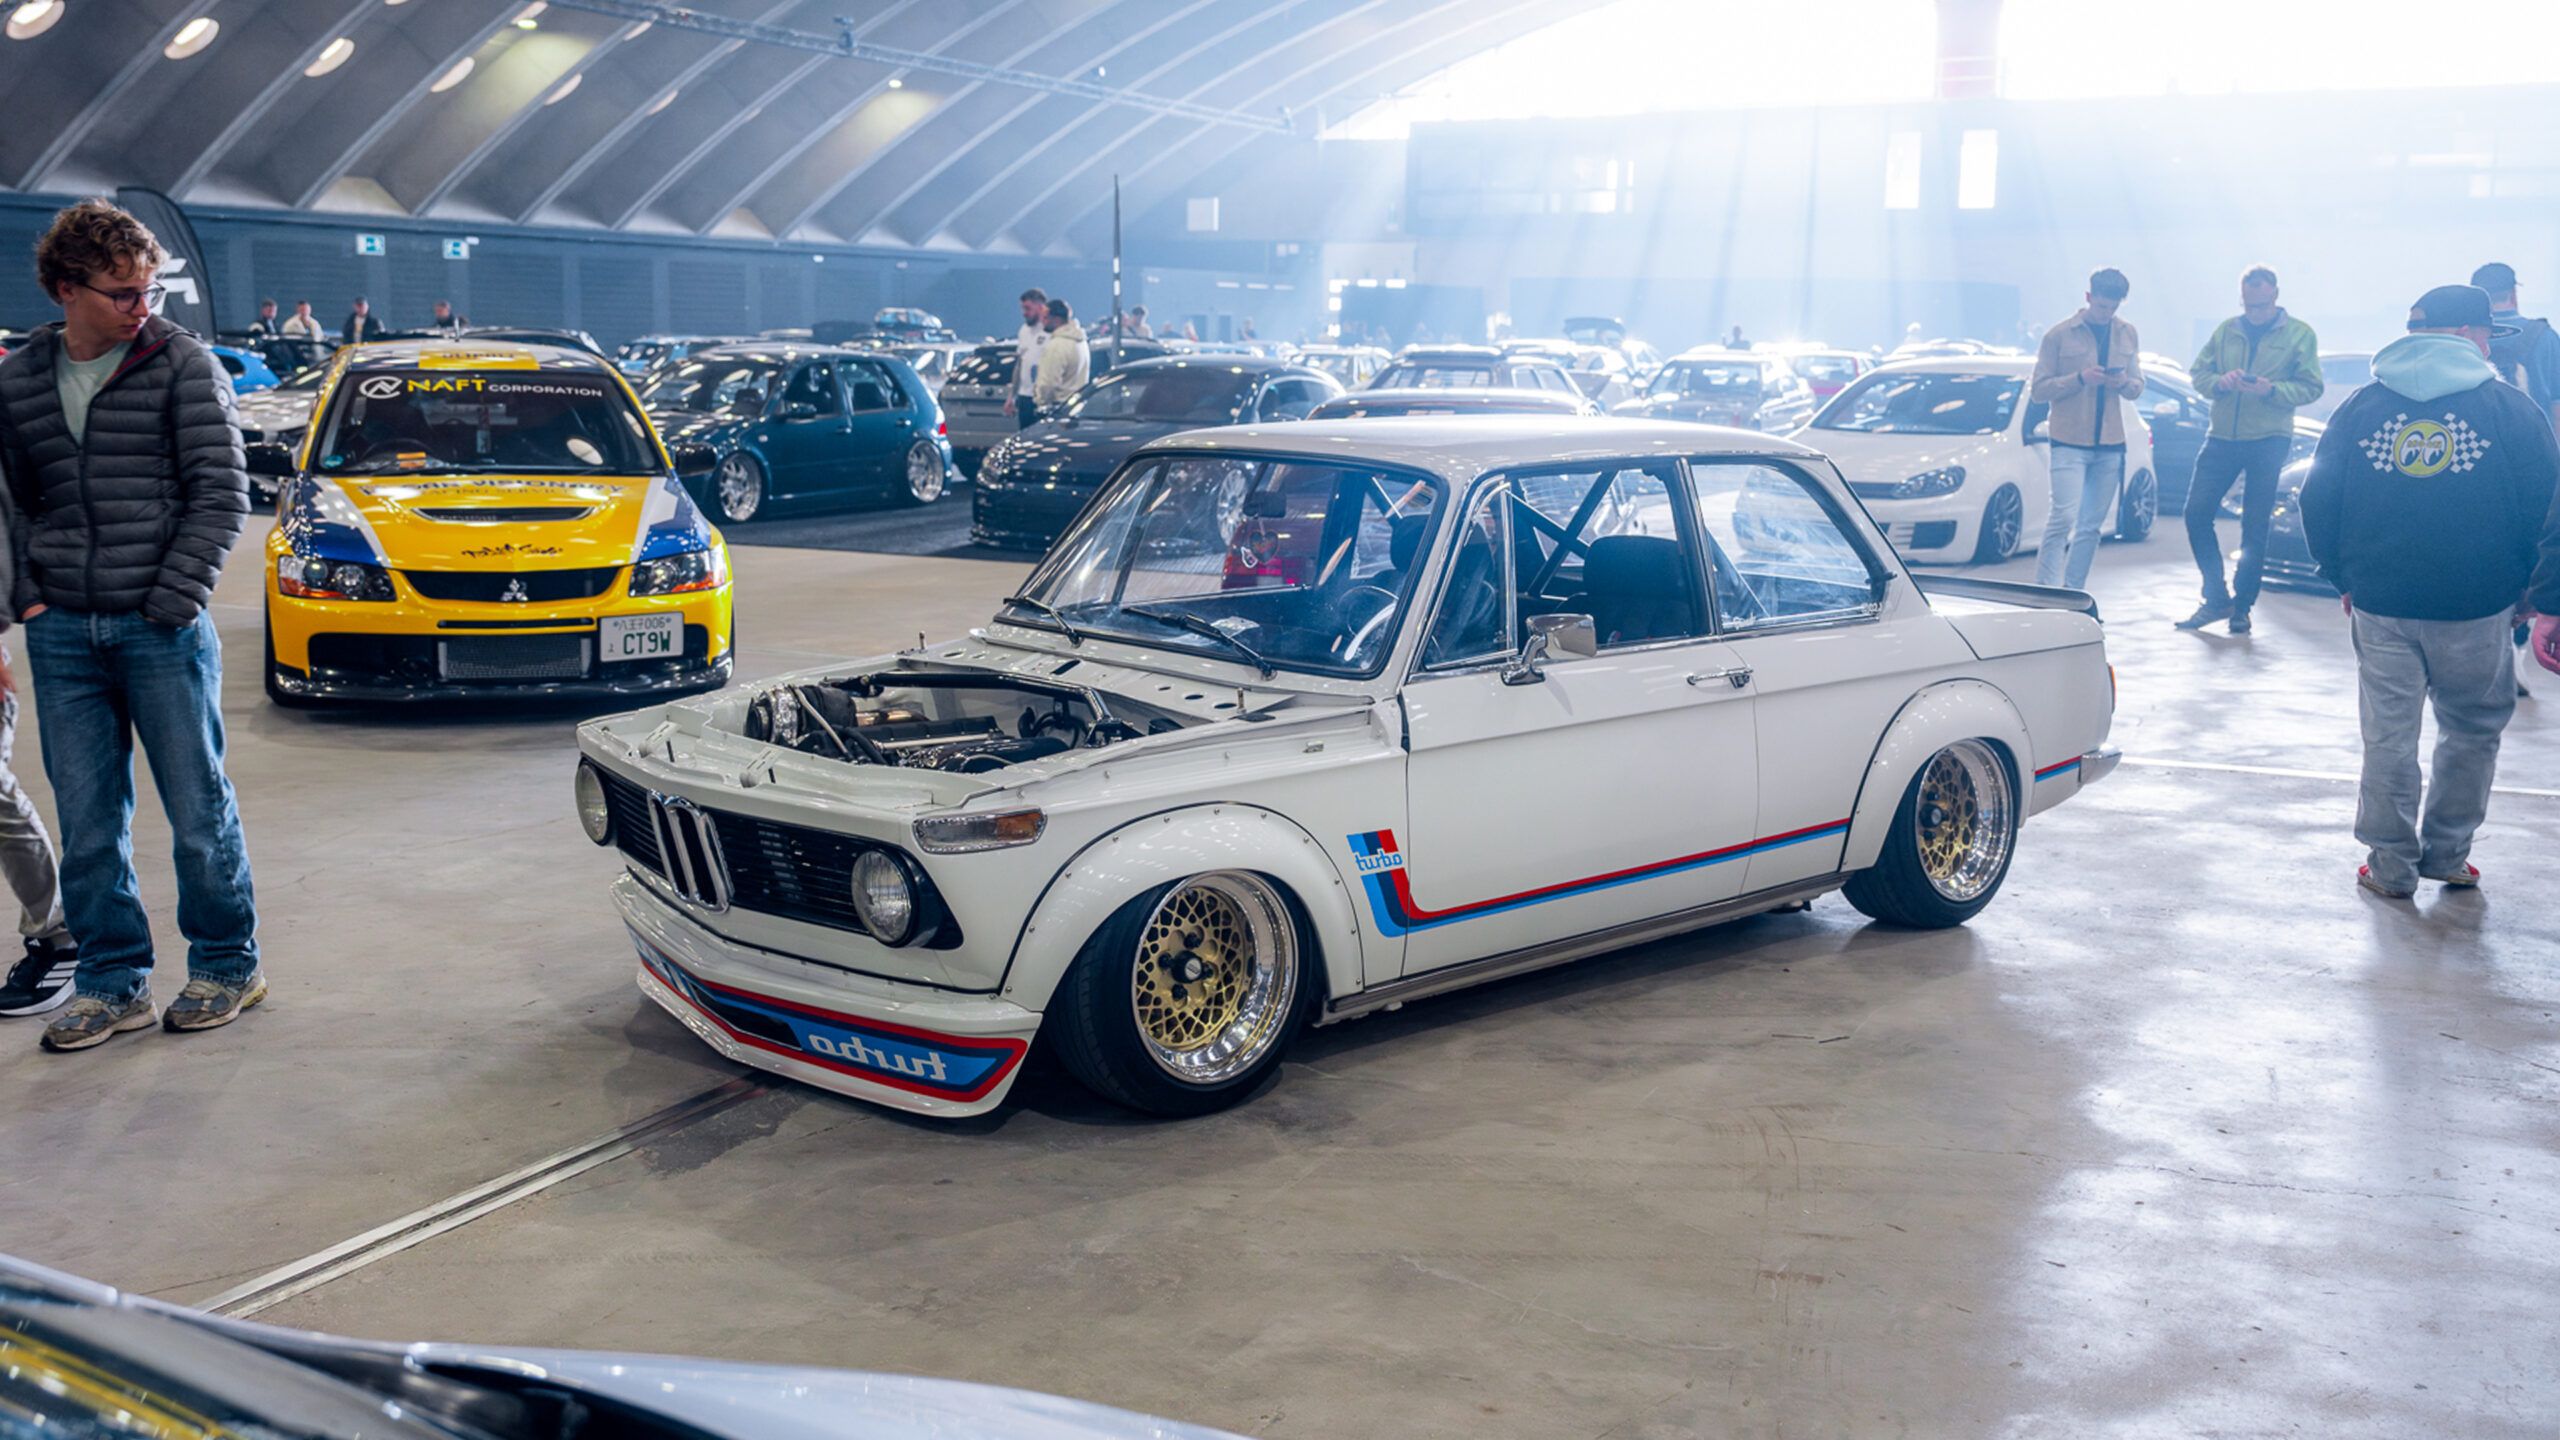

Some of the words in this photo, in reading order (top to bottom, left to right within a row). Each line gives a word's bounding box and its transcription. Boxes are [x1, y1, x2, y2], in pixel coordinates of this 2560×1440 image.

[407, 379, 486, 392] NAFT
[488, 384, 603, 397] CORPORATION
[623, 631, 671, 655] CT9W
[1354, 850, 1403, 871] turbo
